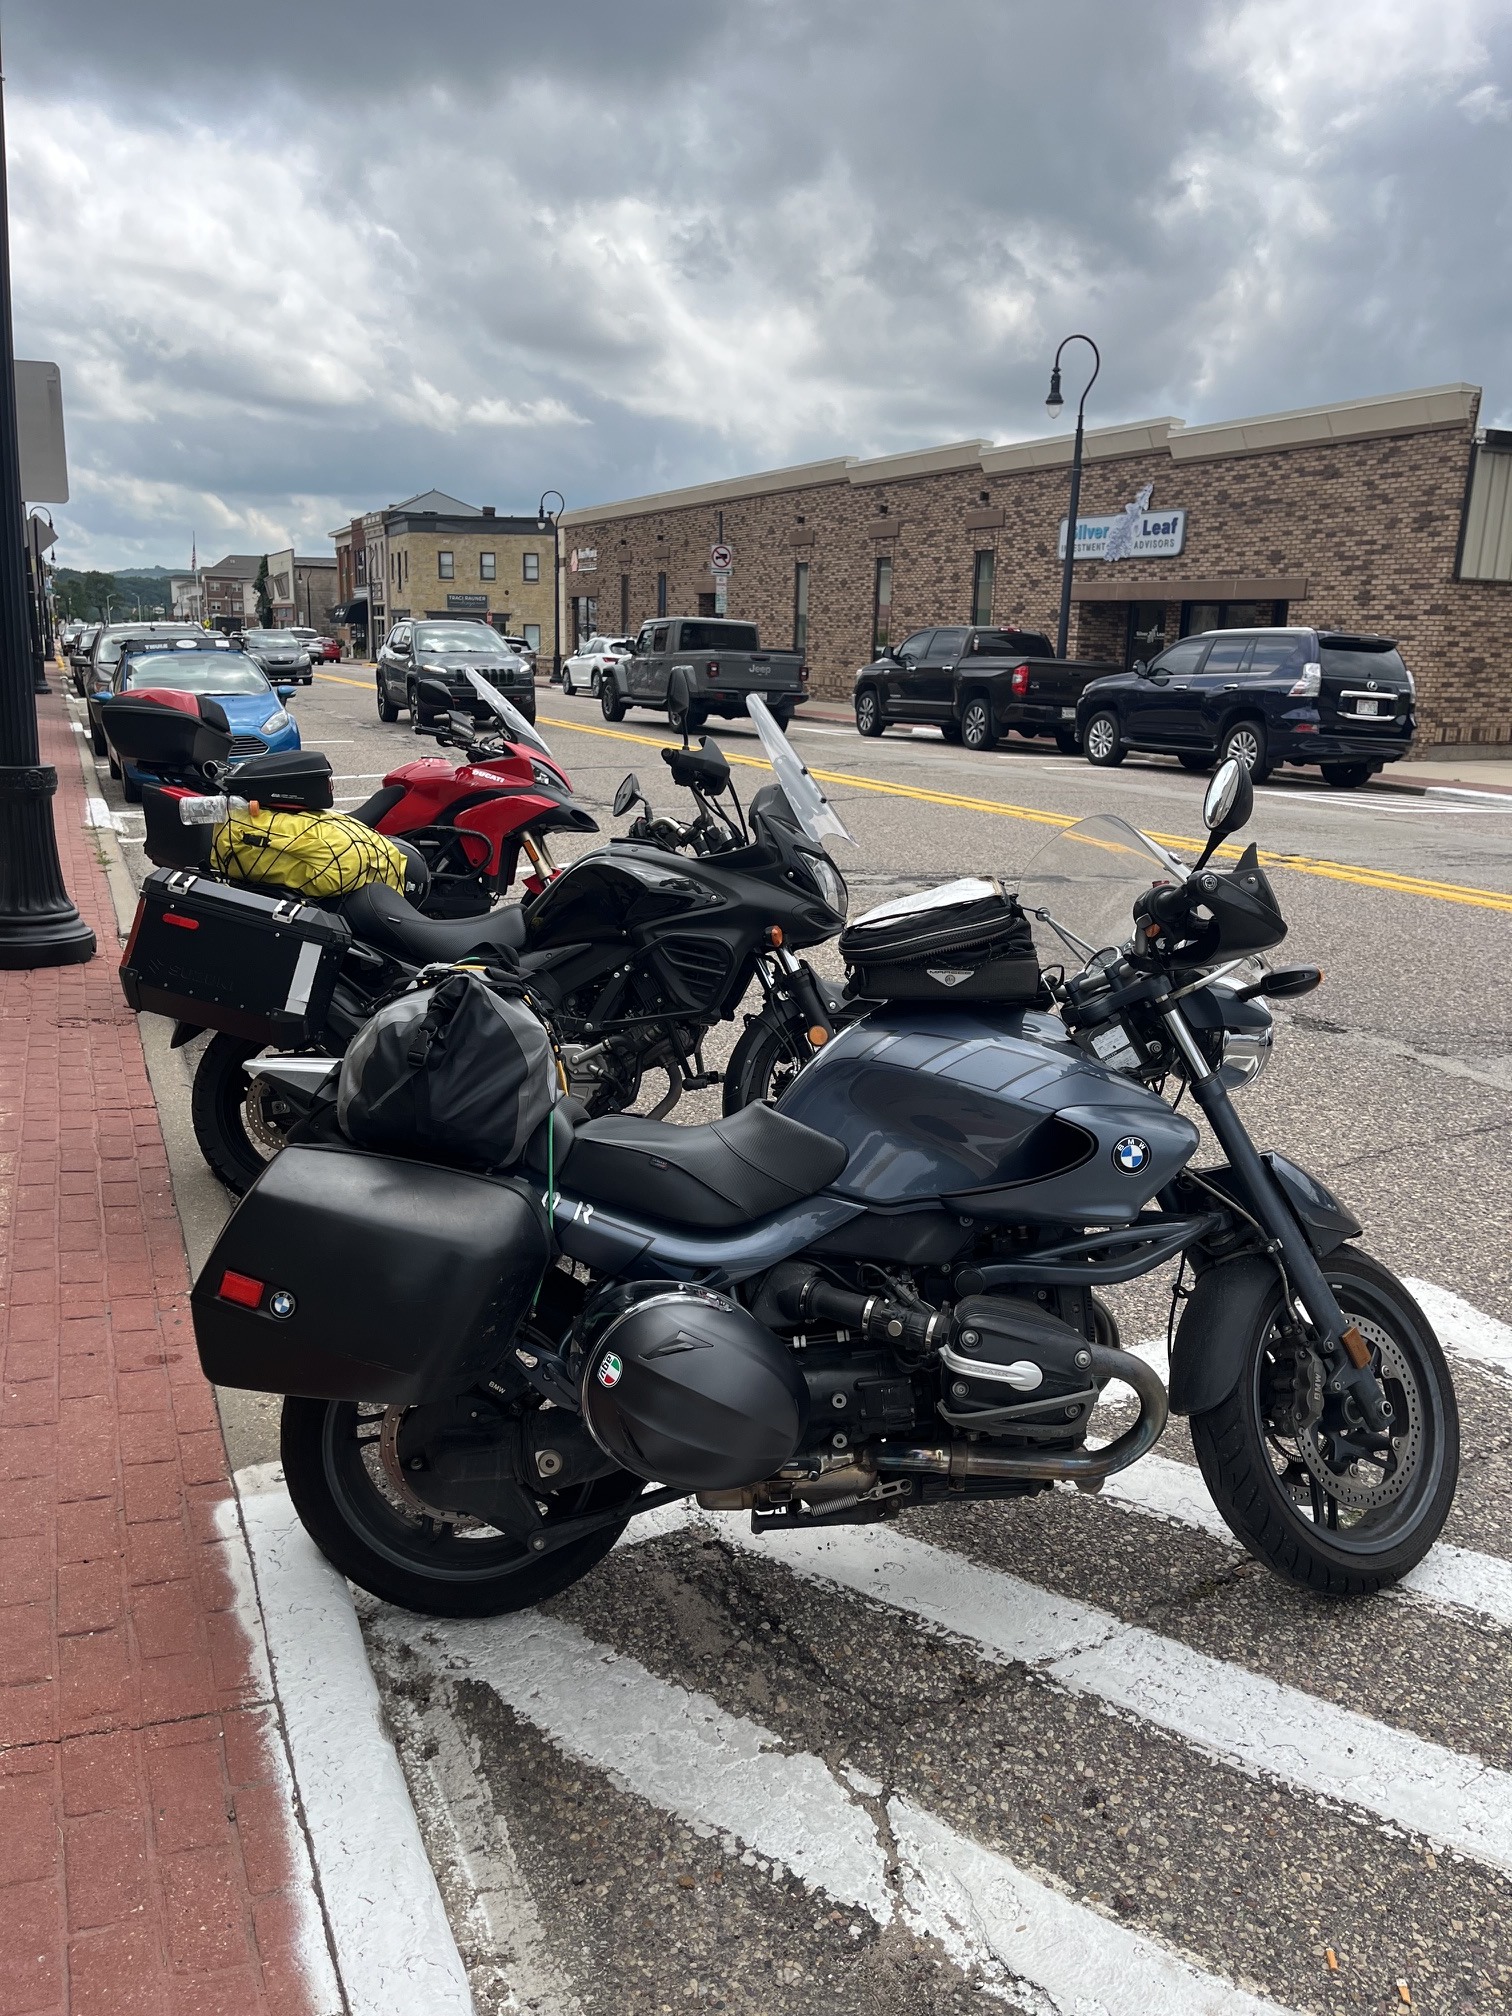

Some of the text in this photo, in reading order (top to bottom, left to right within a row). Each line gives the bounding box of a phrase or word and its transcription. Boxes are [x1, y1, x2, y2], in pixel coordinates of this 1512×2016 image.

[1142, 517, 1179, 536] Leaf
[1061, 539, 1175, 552] IESTMENT ADVISORS
[749, 664, 771, 675] Jeep
[472, 769, 505, 783] DUCATI
[573, 1201, 595, 1225] R
[488, 1380, 506, 1394] BMW
[1313, 1373, 1322, 1400] BMW
